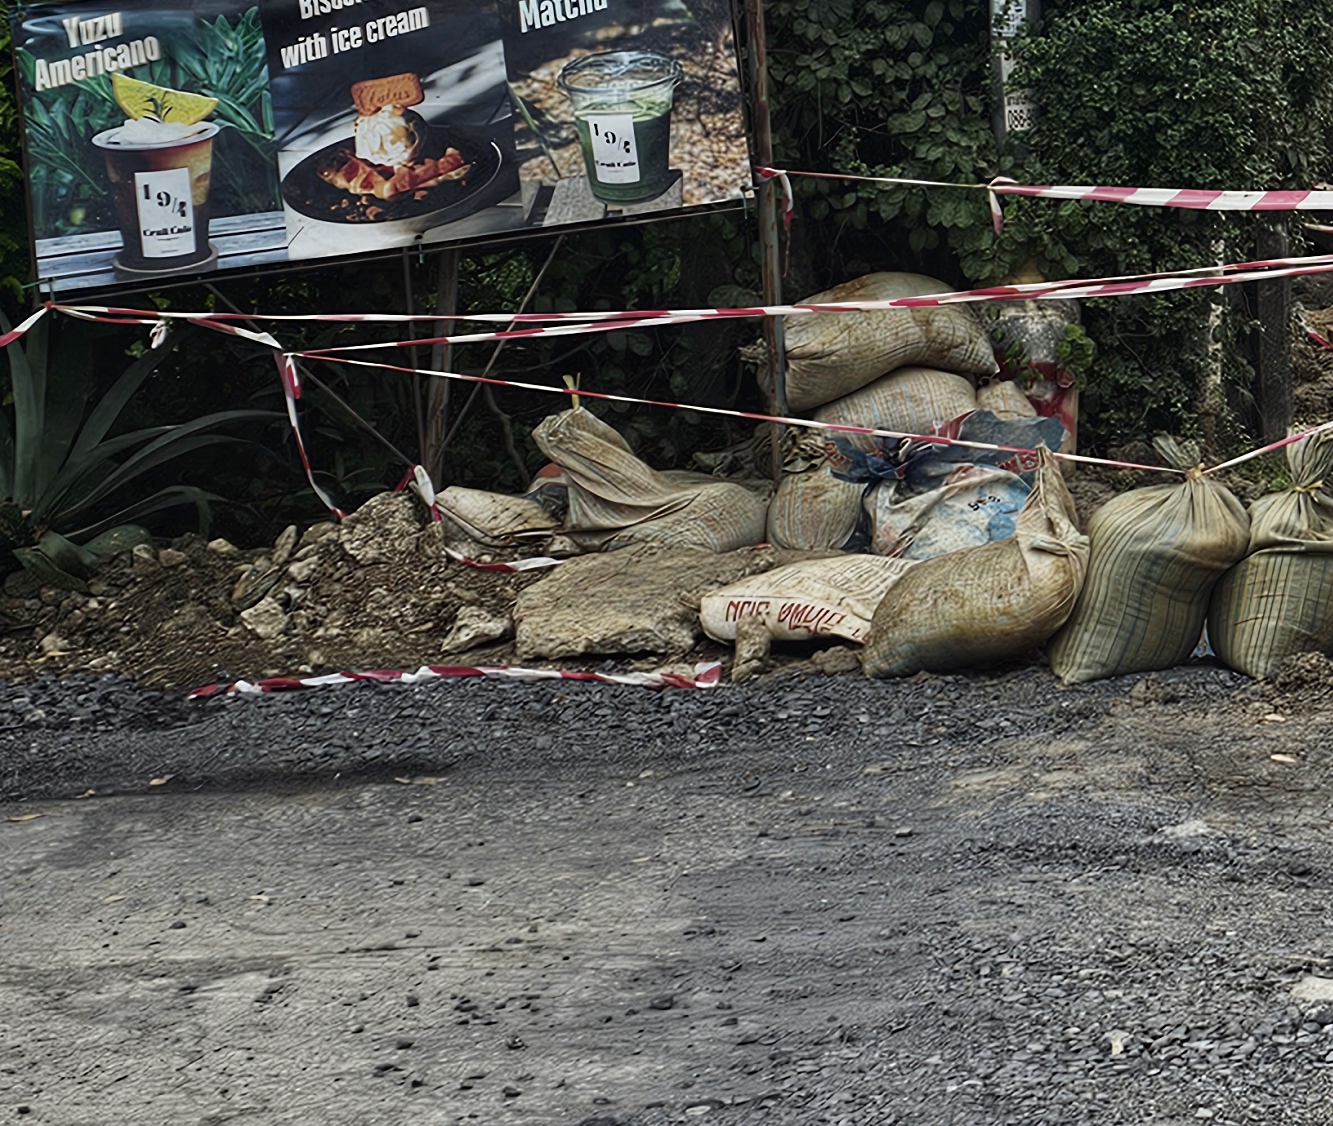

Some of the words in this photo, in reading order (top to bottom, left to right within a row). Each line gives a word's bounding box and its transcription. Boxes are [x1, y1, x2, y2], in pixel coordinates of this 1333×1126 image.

[62, 12, 123, 48] Yuzu
[280, 32, 328, 69] with
[330, 27, 363, 54] ice
[366, 7, 430, 43] cream
[35, 36, 160, 91] Americano
